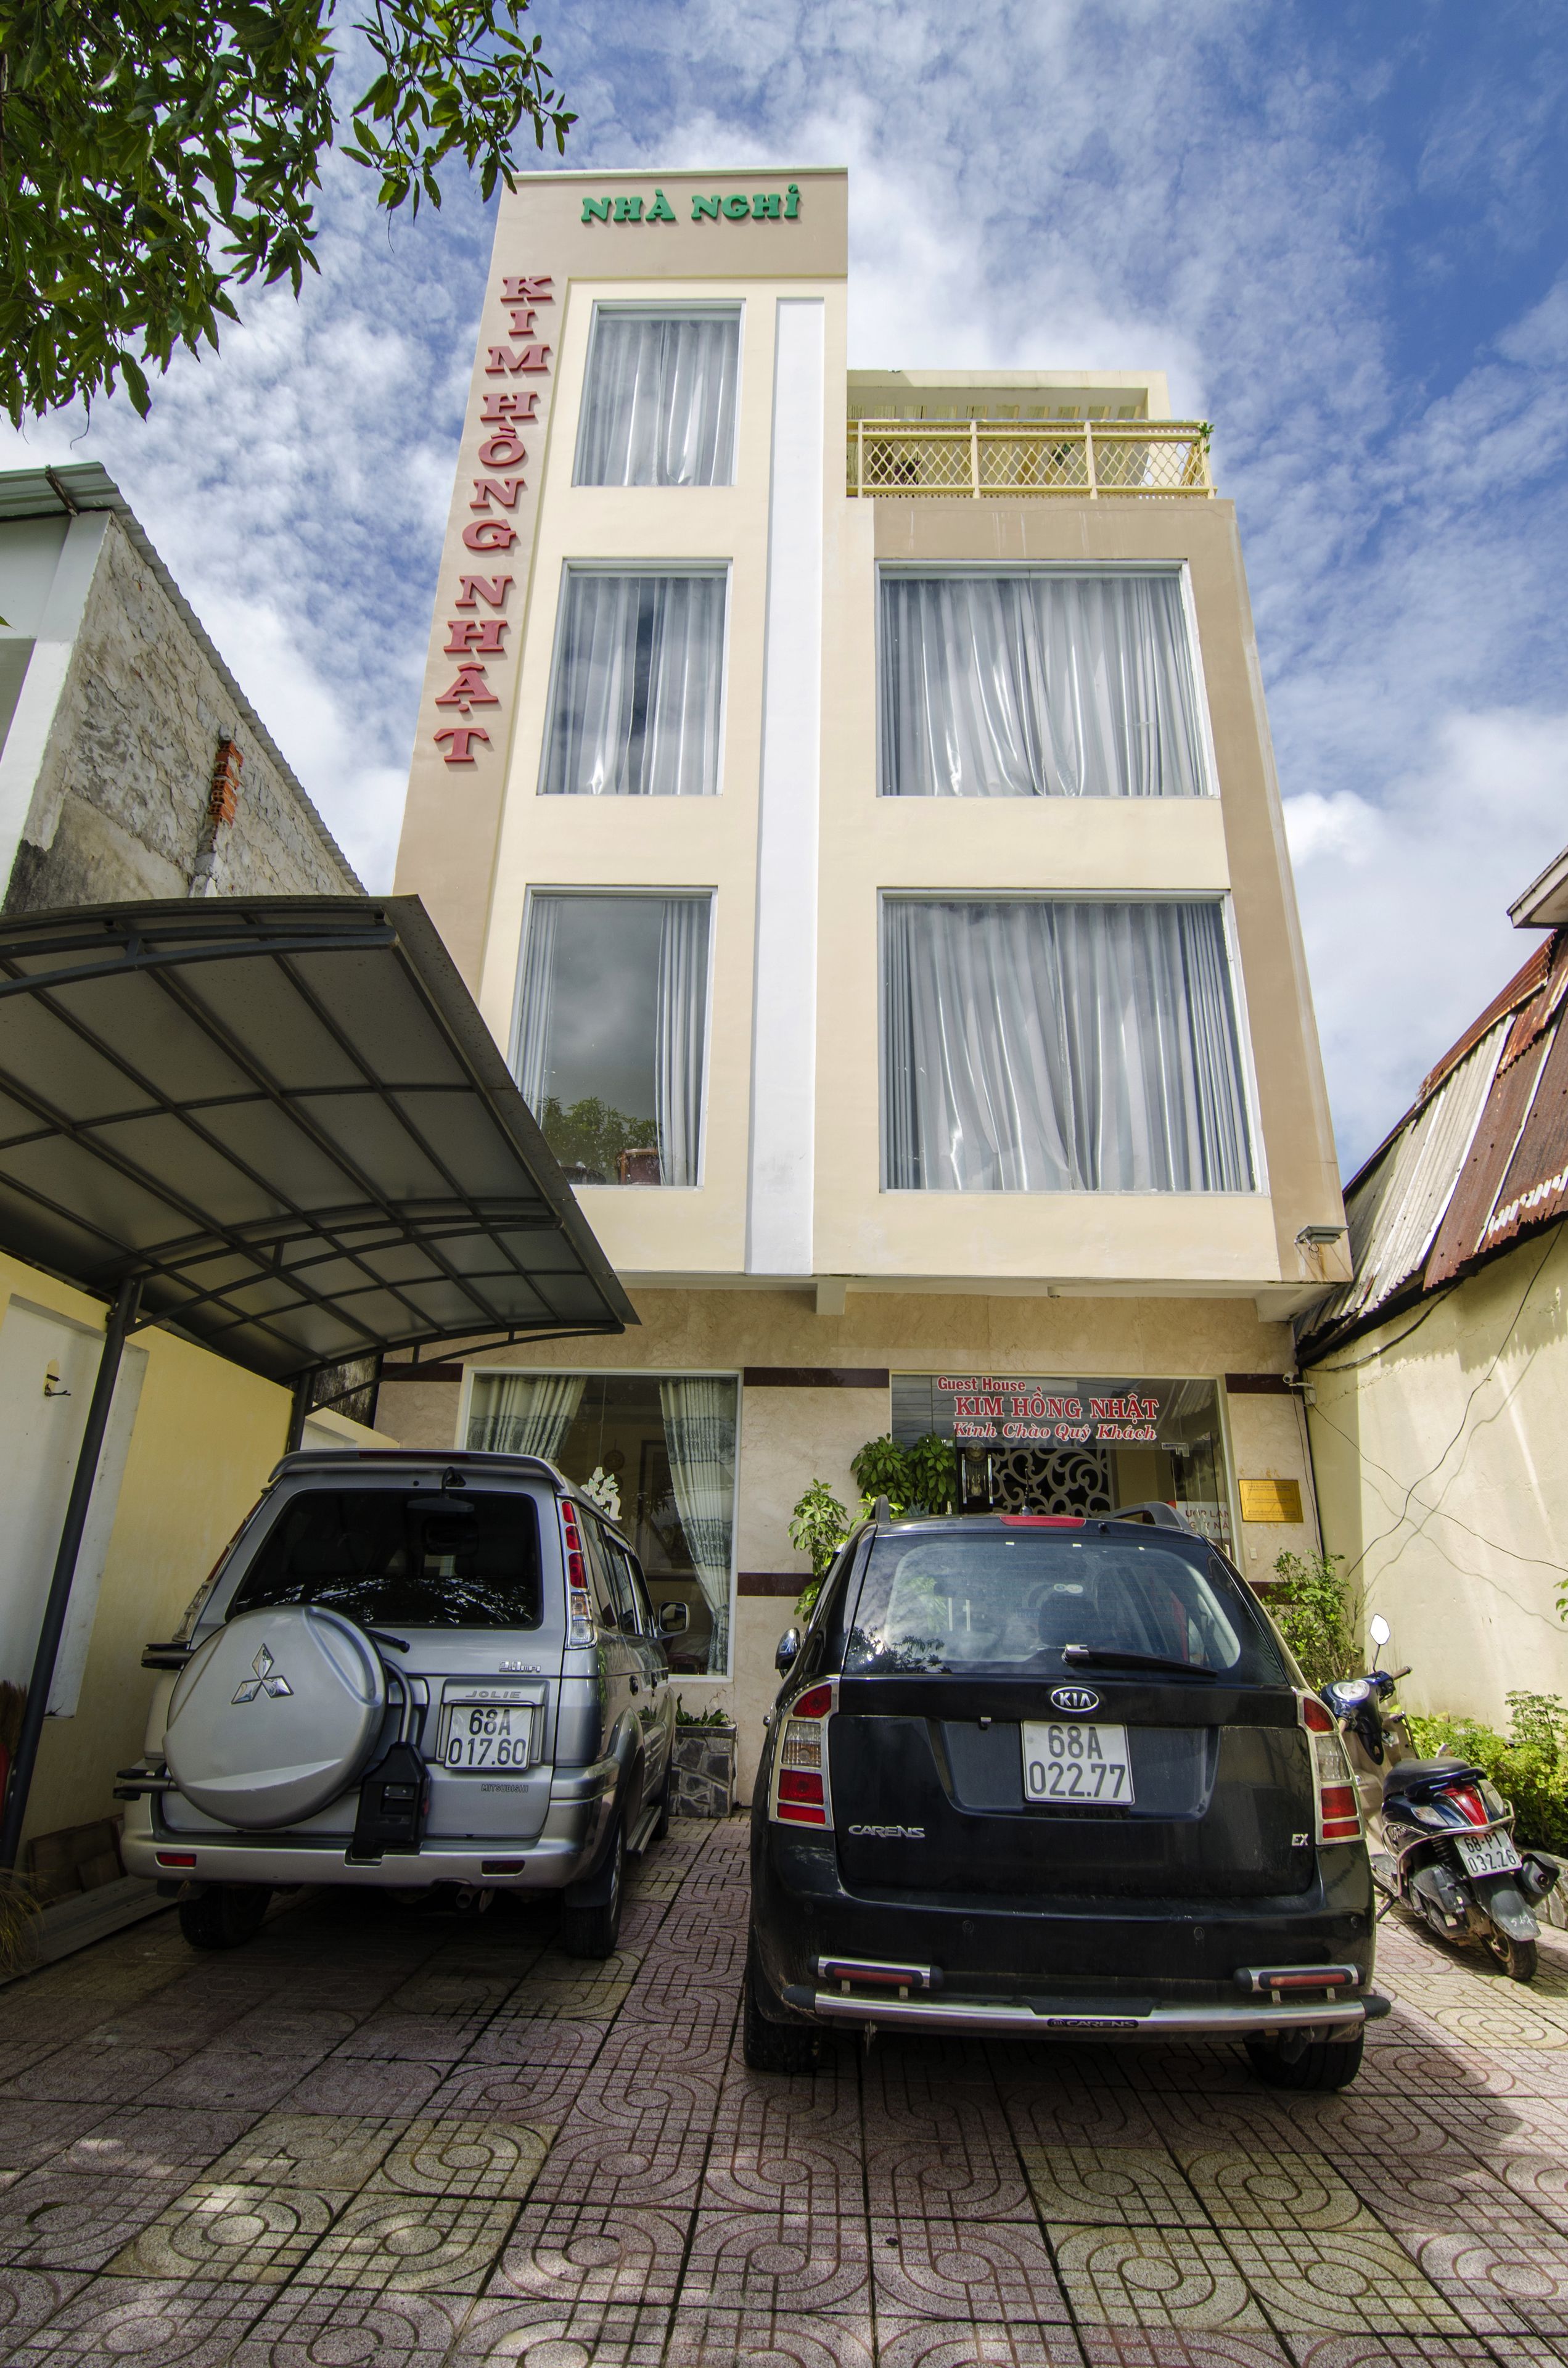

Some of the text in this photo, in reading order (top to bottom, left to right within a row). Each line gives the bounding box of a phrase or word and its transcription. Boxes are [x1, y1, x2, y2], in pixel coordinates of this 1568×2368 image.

[581, 183, 801, 223] NHÀ NGHỈ
[433, 276, 552, 762] KIM HỒNG NHẬT
[937, 1376, 1026, 1392] Guest House
[954, 1386, 1160, 1424] KIM HỒNG NHẬT
[953, 1421, 1157, 1442] Kính Chào Quý Khách
[466, 1690, 521, 1699] JOLIE
[469, 1709, 511, 1736] 68A
[448, 1738, 527, 1765] 017.60
[1048, 1725, 1103, 1760] 68A
[481, 1783, 528, 1793] MITSUBISHI
[1029, 1761, 1126, 1798] 022.77
[848, 1825, 925, 1838] CARENS
[1292, 1833, 1308, 1846] EX
[1467, 1849, 1516, 1873] 032.26
